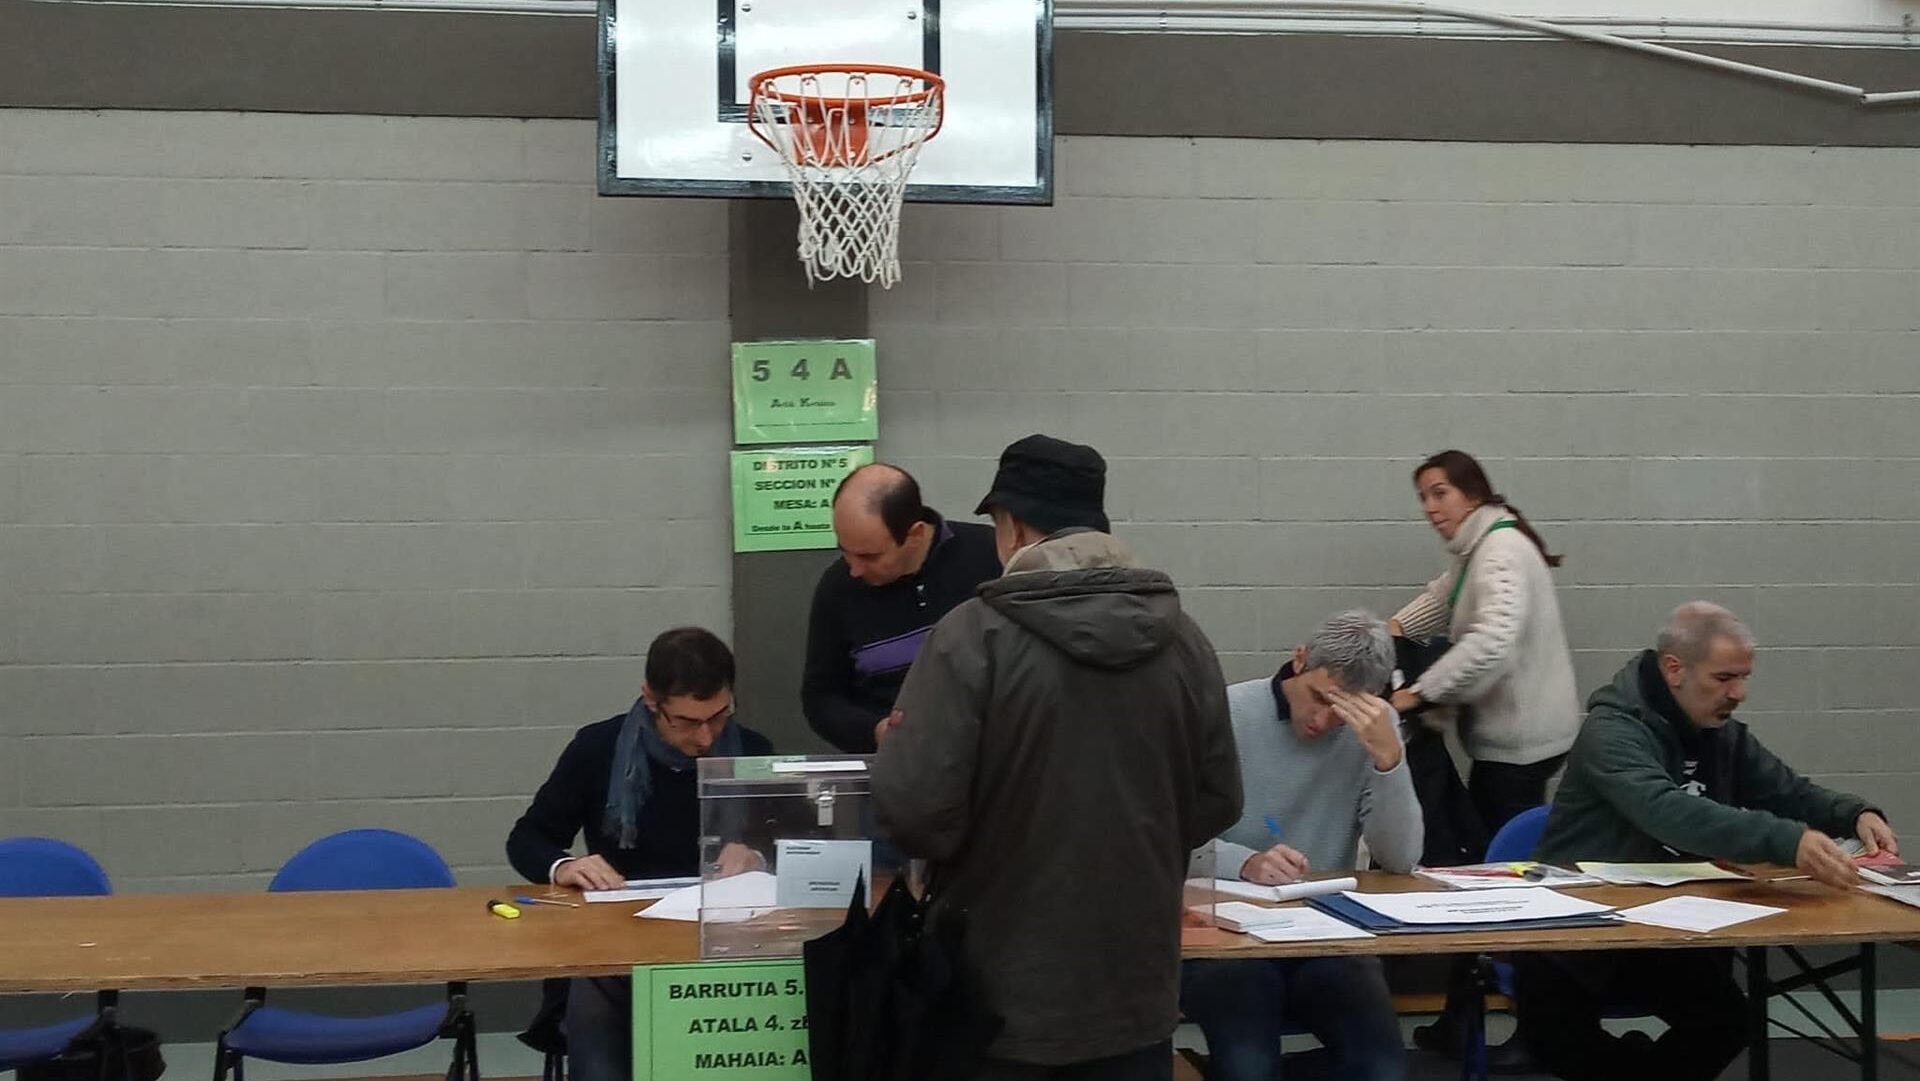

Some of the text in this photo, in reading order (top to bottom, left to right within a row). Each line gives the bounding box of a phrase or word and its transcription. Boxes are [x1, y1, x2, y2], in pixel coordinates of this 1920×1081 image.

[752, 358, 852, 382] 5 4 A
[753, 459, 818, 471] DISTRITO
[839, 458, 848, 468] 5
[755, 479, 816, 491] SECCION
[774, 499, 830, 510] MESA: A
[793, 521, 803, 530] A
[669, 980, 804, 999] BARRUTIA 5.
[688, 1017, 758, 1034] ATALA
[765, 1015, 784, 1031] 4.
[695, 1049, 808, 1069] MAHAIA: A
